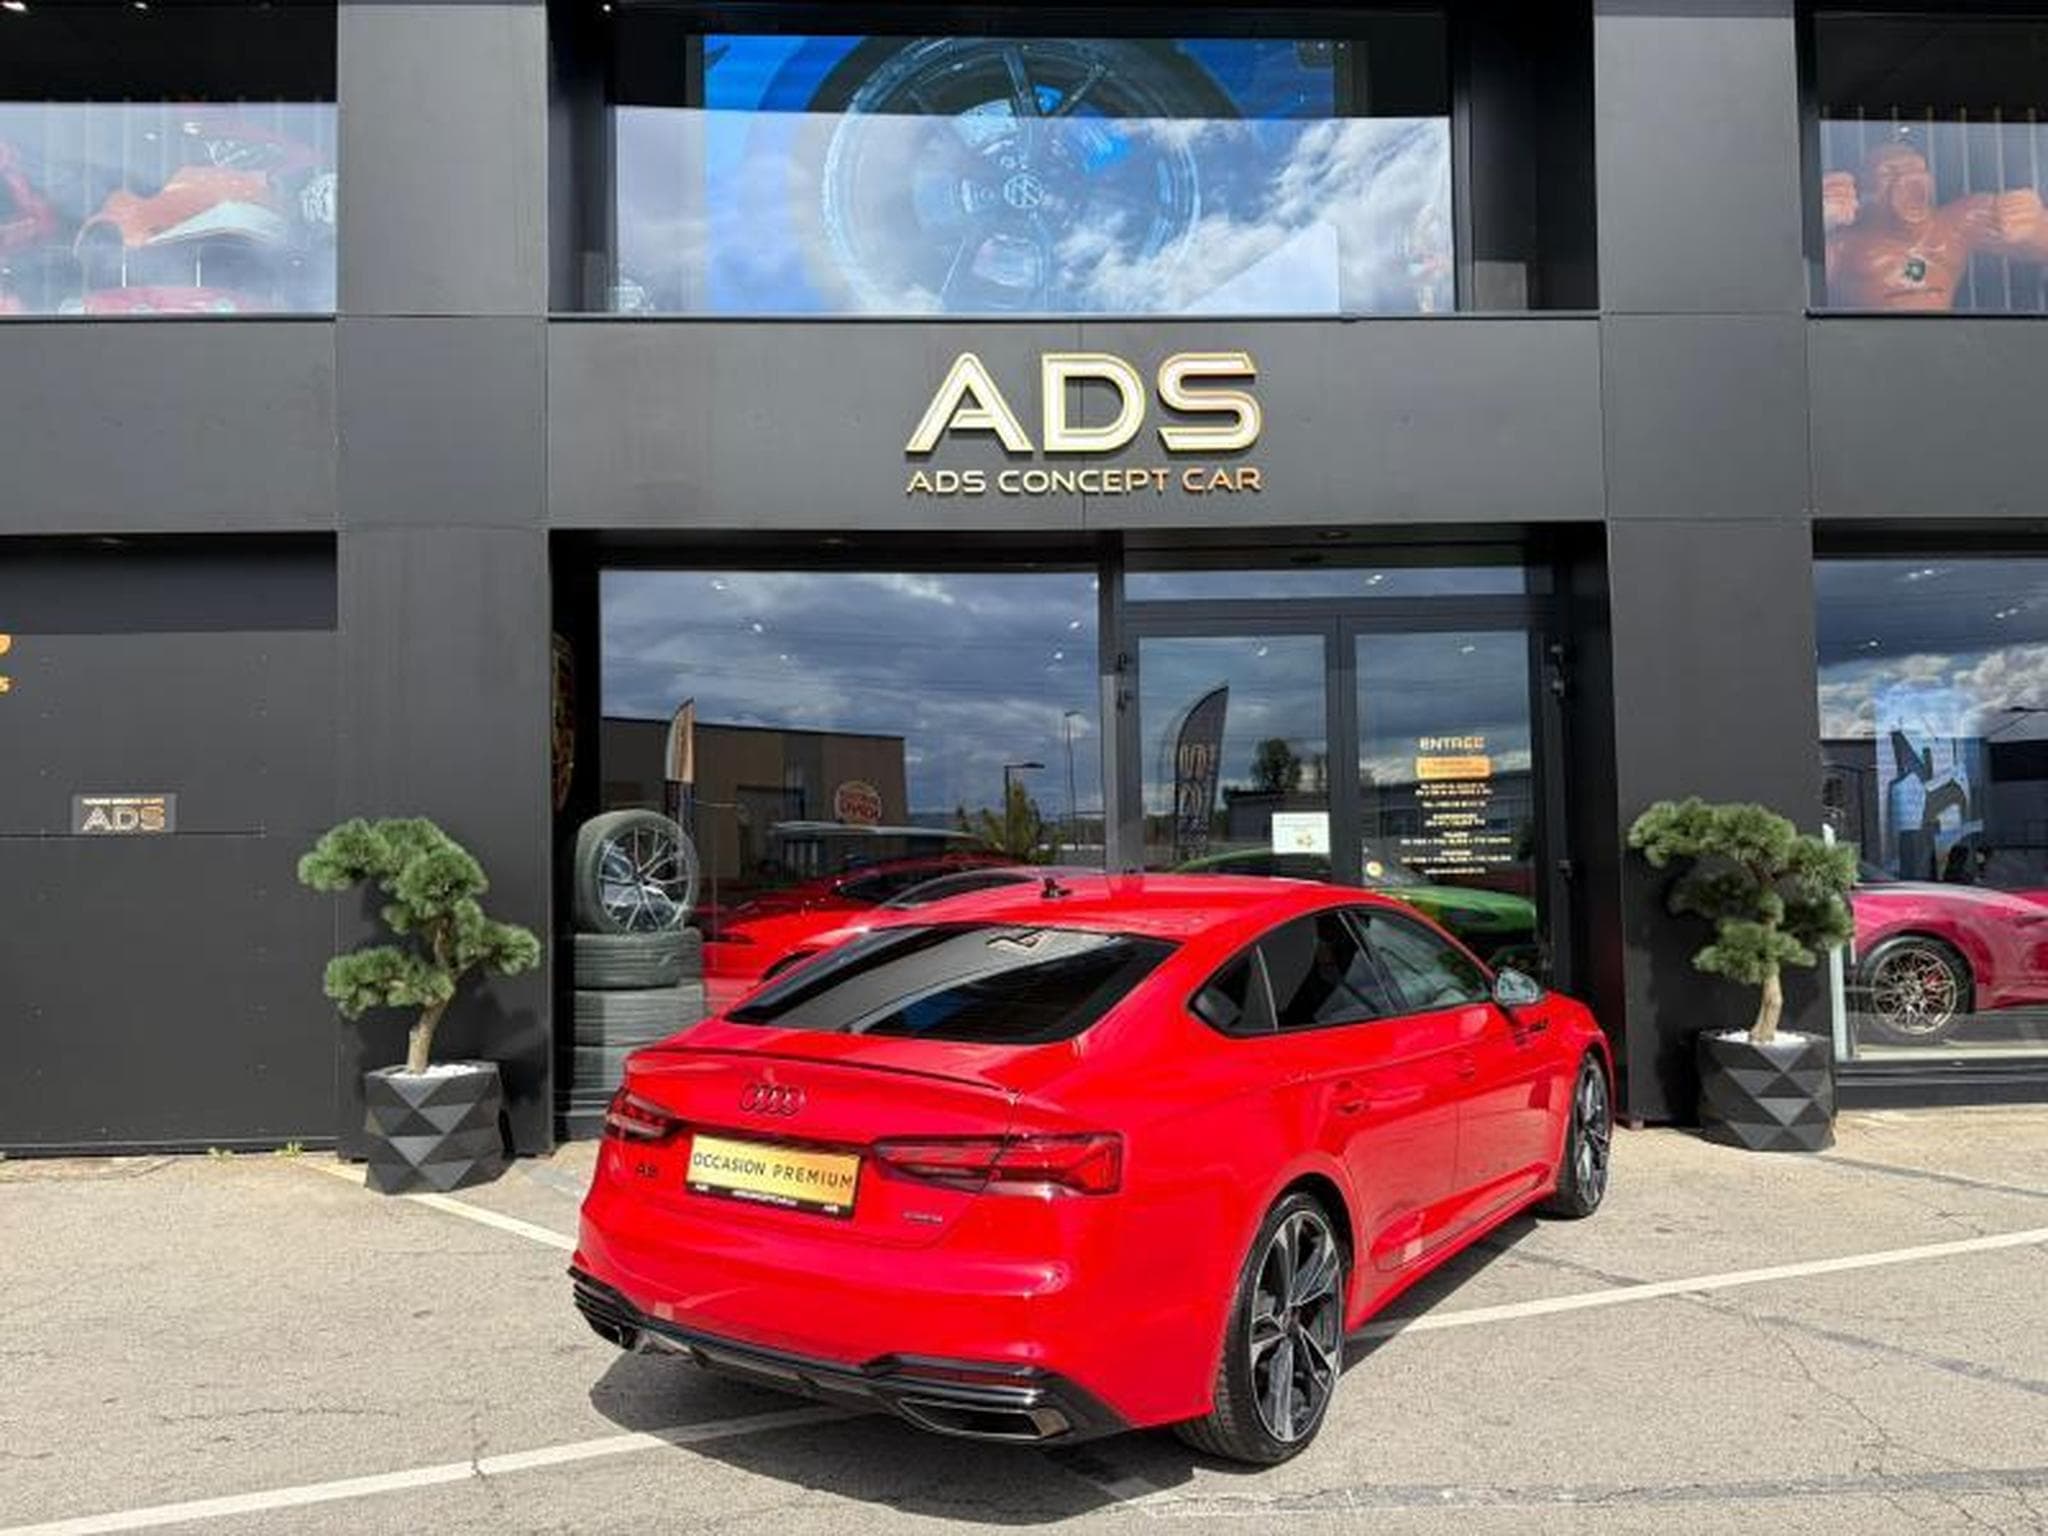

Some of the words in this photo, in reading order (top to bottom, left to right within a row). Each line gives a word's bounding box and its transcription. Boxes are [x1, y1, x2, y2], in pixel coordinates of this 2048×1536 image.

[905, 351, 1262, 453] ADS
[906, 470, 987, 494] ADS
[999, 469, 1170, 494] CONCEPT
[1182, 467, 1262, 491] CAR
[82, 806, 165, 831] ADS
[693, 1152, 767, 1176] OCCASION
[772, 1163, 853, 1189] PREMIUM
